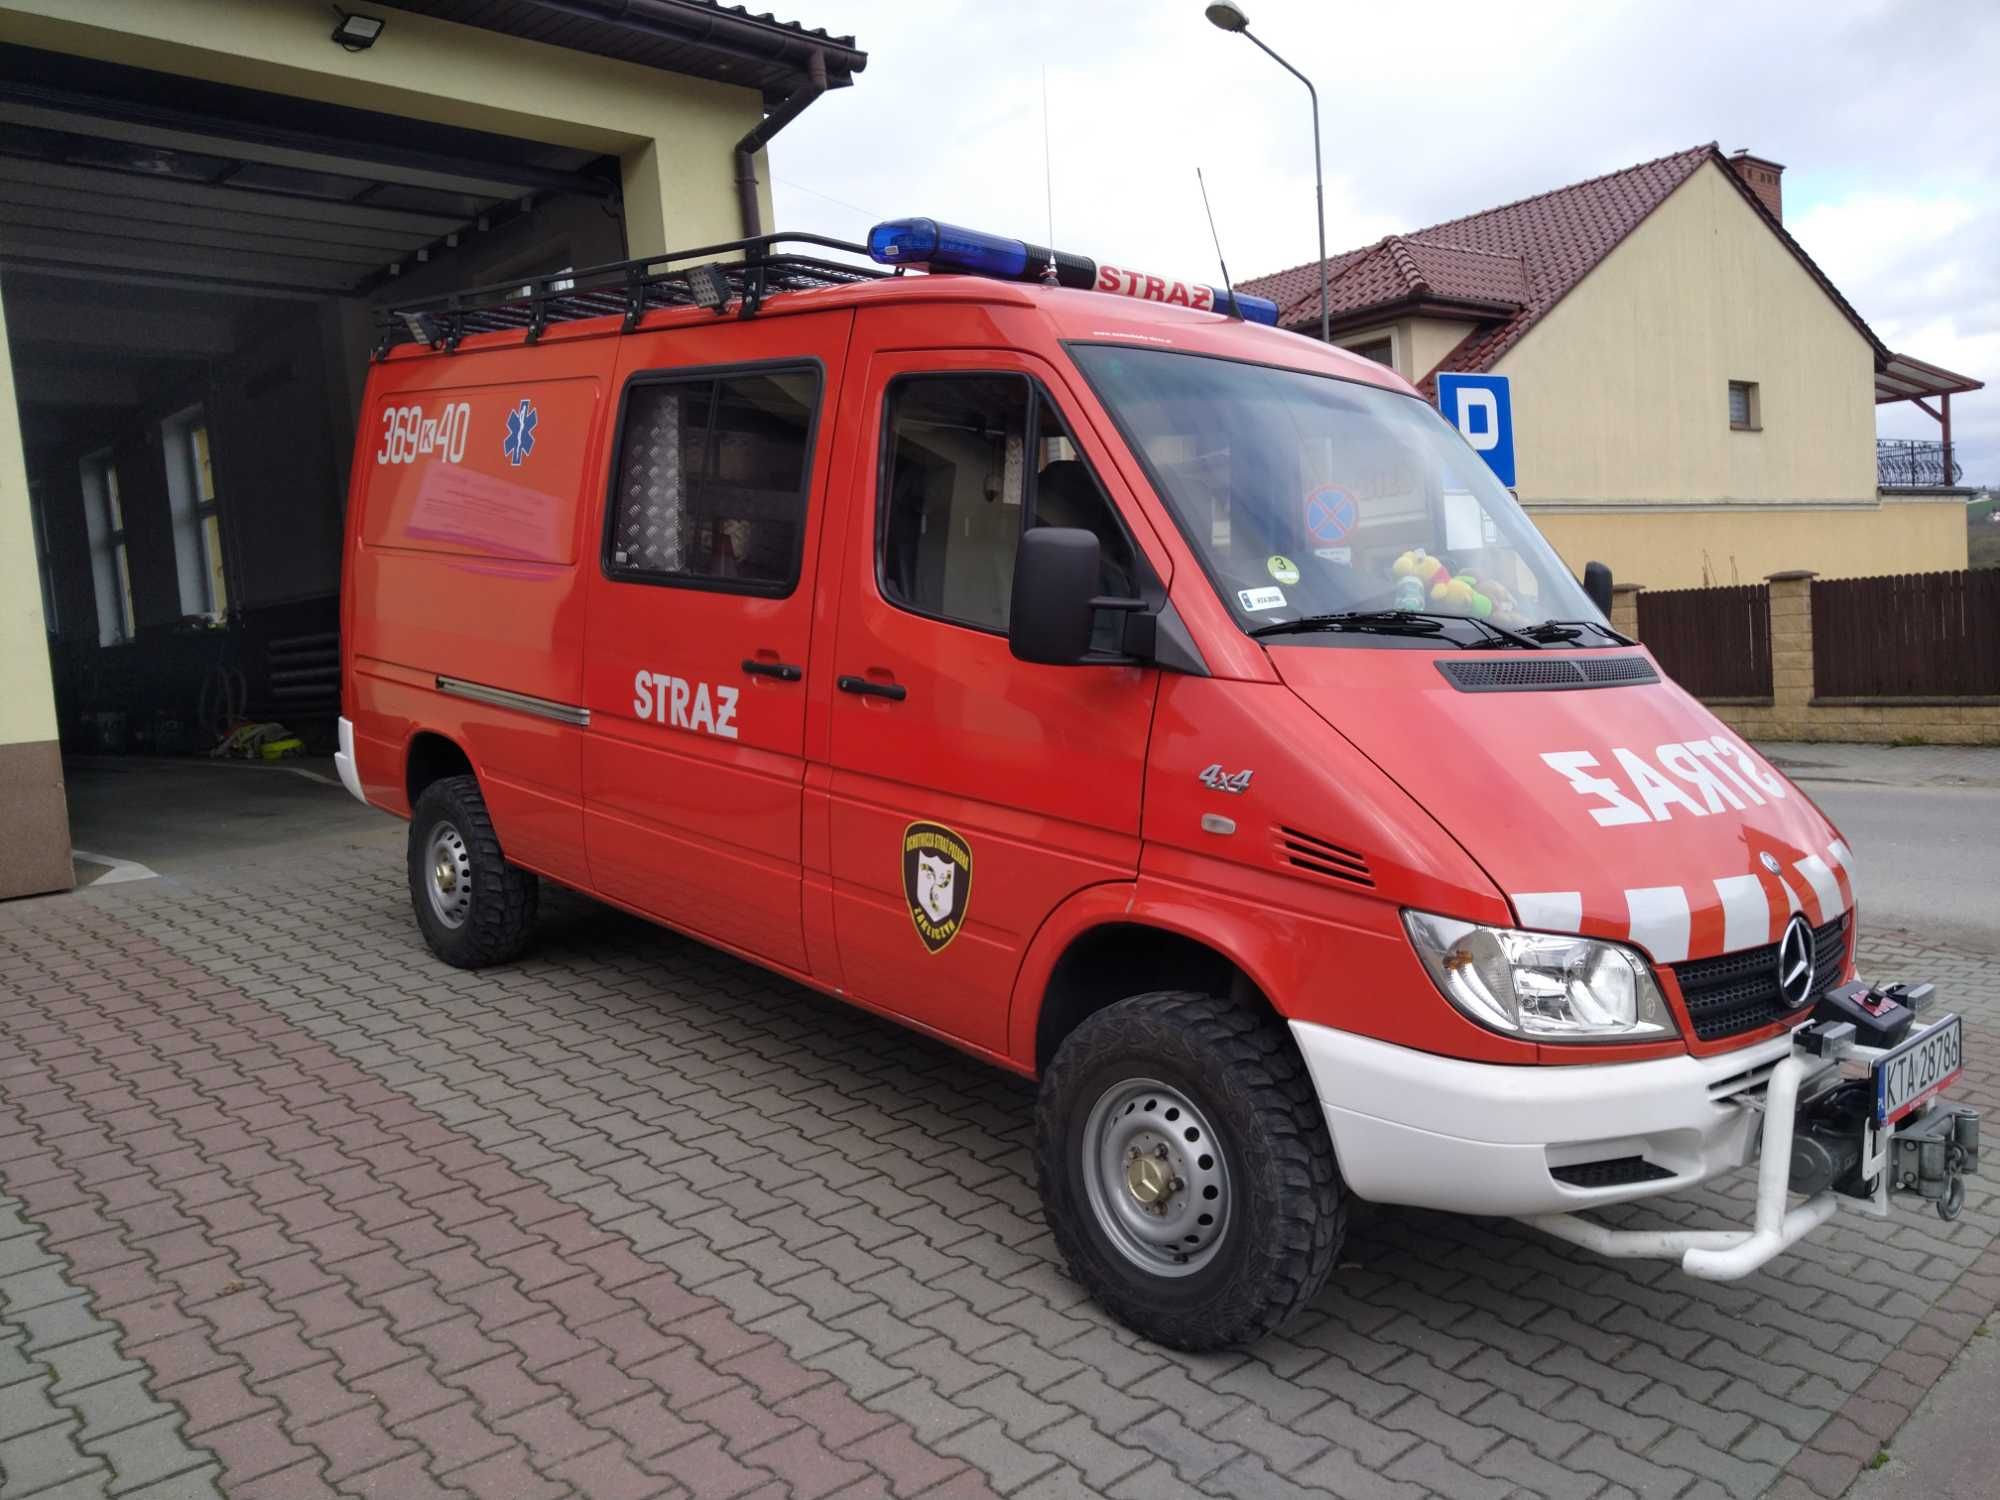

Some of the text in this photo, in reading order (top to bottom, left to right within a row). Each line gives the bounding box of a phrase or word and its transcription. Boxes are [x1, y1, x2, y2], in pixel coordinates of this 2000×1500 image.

[1456, 387, 1499, 450] D
[1199, 763, 1254, 794] 4x4
[1887, 1053, 1915, 1107] KTA
[1919, 1030, 1958, 1088] 28786
